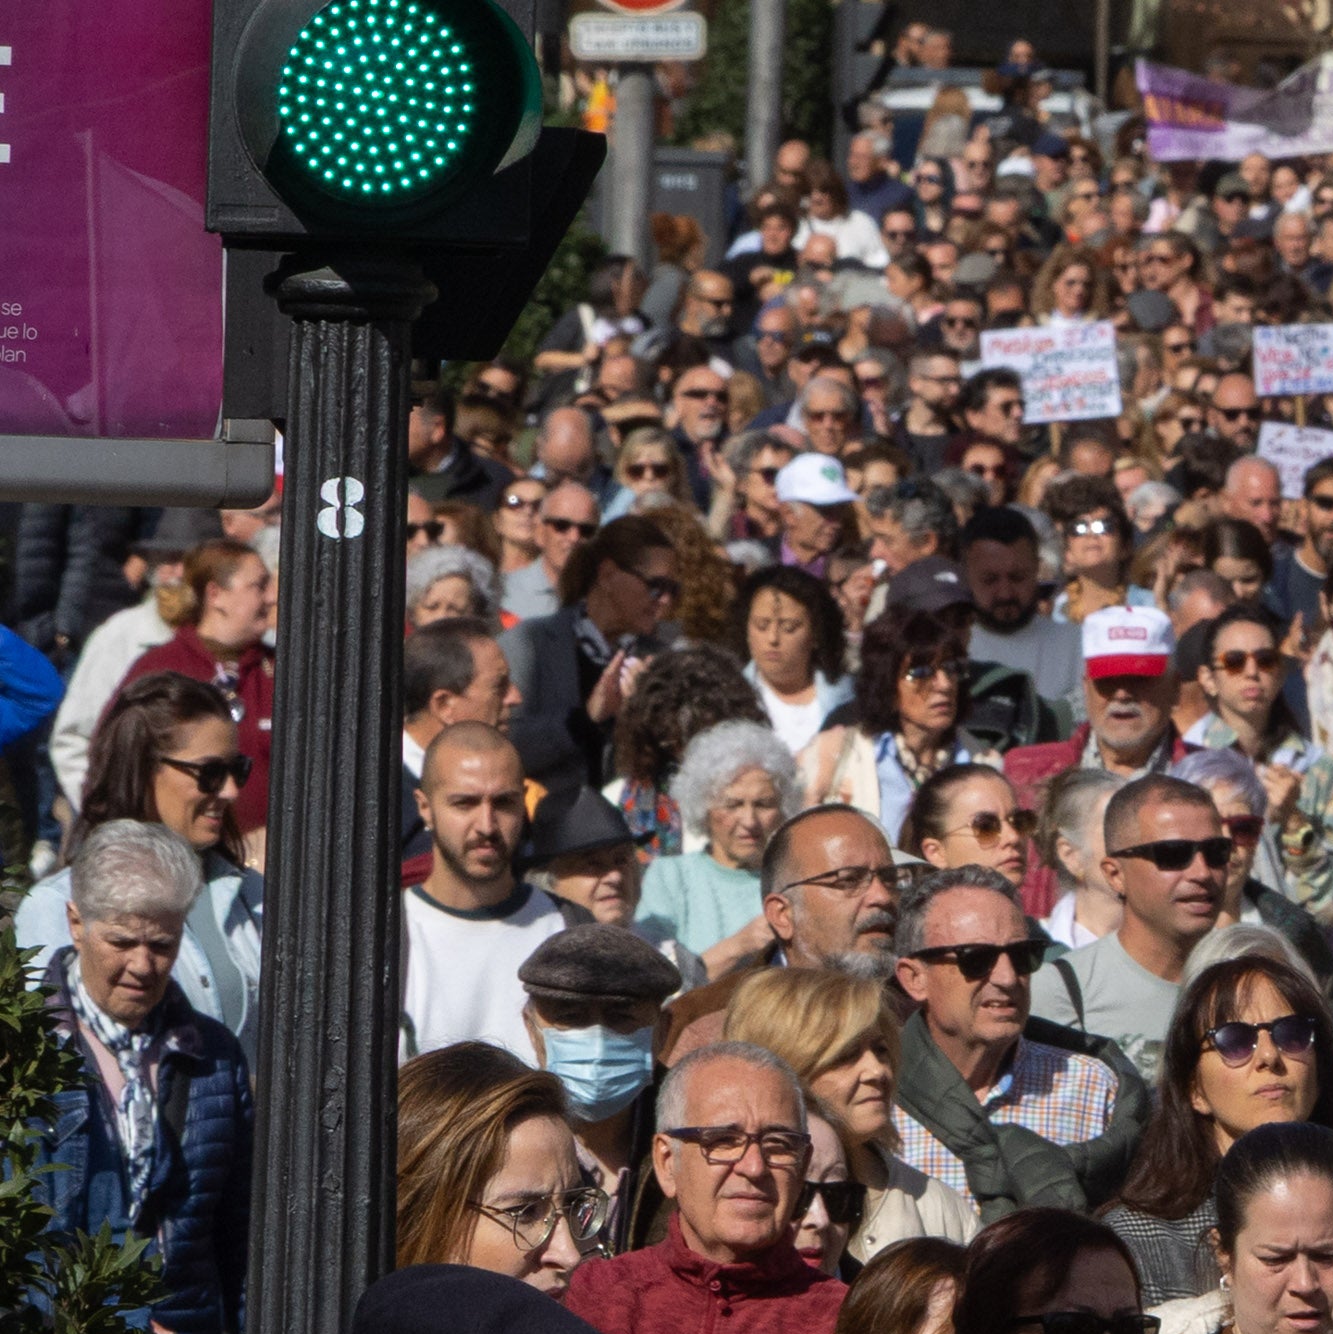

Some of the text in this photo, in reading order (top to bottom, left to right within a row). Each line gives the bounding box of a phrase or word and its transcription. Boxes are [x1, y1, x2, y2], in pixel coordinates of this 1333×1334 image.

[1, 302, 22, 316] se
[23, 323, 38, 340] lo
[317, 476, 365, 539] 8
